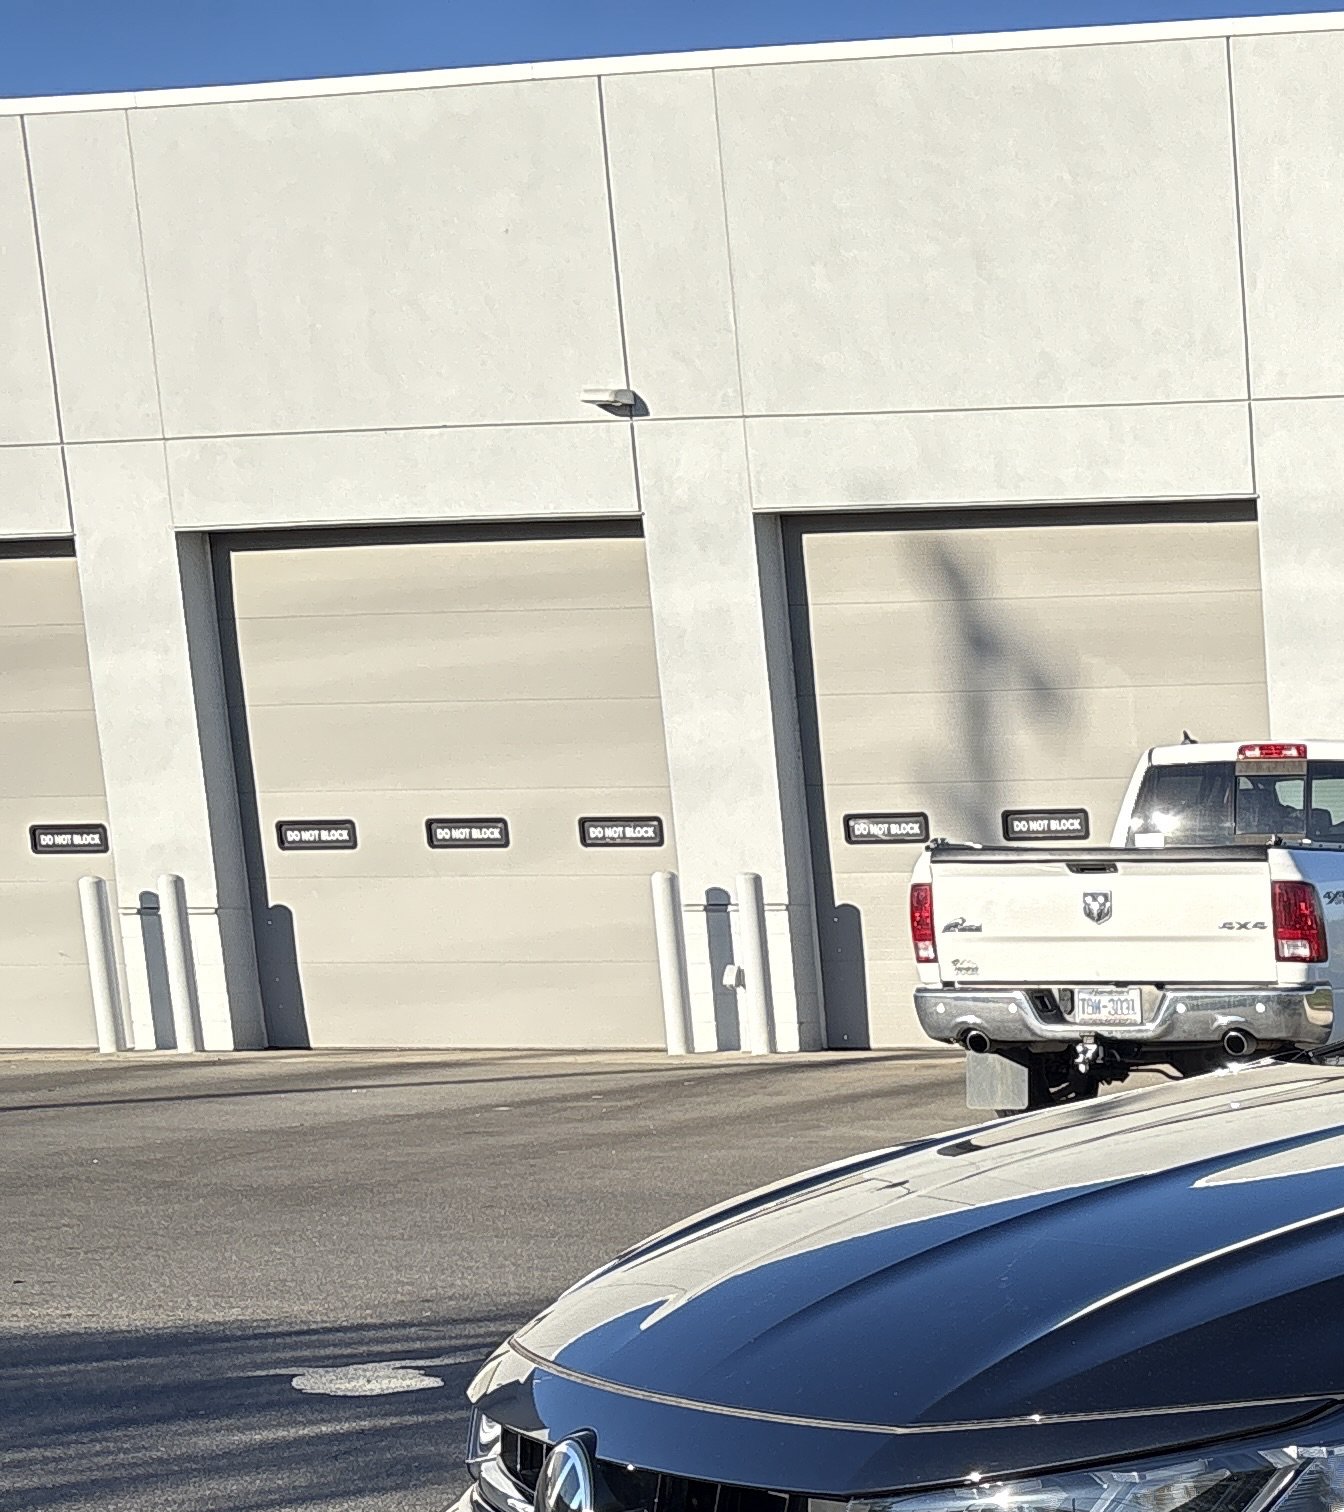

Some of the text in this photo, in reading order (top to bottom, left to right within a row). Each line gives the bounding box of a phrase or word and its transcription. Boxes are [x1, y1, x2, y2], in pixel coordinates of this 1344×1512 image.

[854, 822, 921, 835] DO NOT BLOCK
[1013, 818, 1082, 832] DO NOT BLOCK
[286, 829, 350, 842] DO NOT BLOCK
[436, 827, 502, 840] DO NOT BLOCK
[589, 826, 655, 838] DO NOT BLOCK
[40, 833, 101, 845] DO NOT BLOCK
